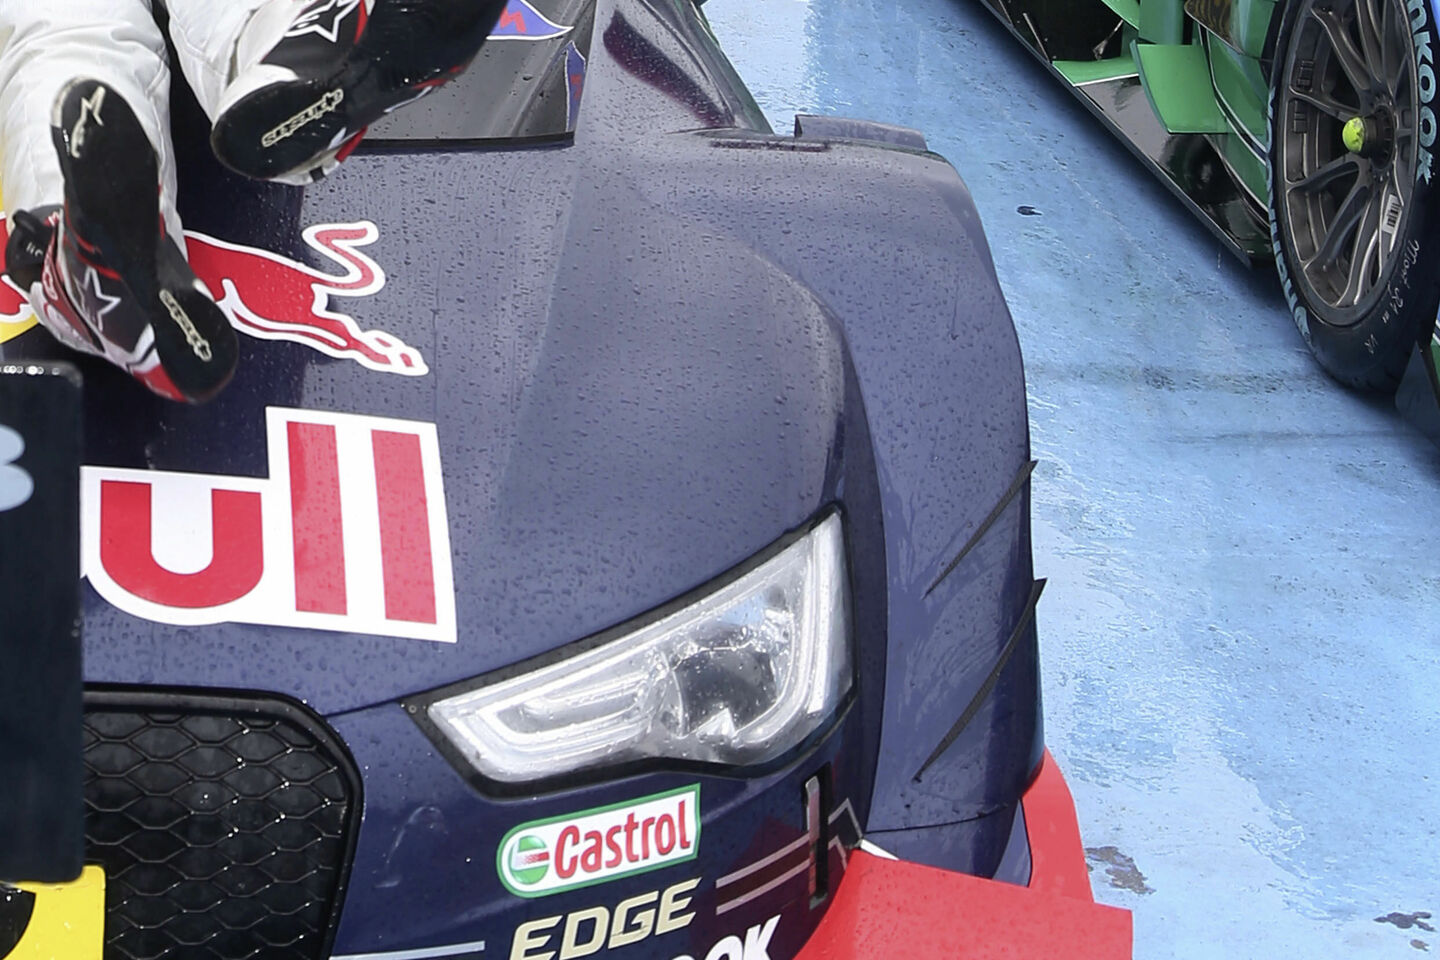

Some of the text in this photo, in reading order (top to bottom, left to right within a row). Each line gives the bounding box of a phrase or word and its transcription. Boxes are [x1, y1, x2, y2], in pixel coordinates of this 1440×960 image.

[79, 406, 459, 643] ull
[554, 798, 692, 880] Castrol
[510, 877, 703, 960] EDGE
